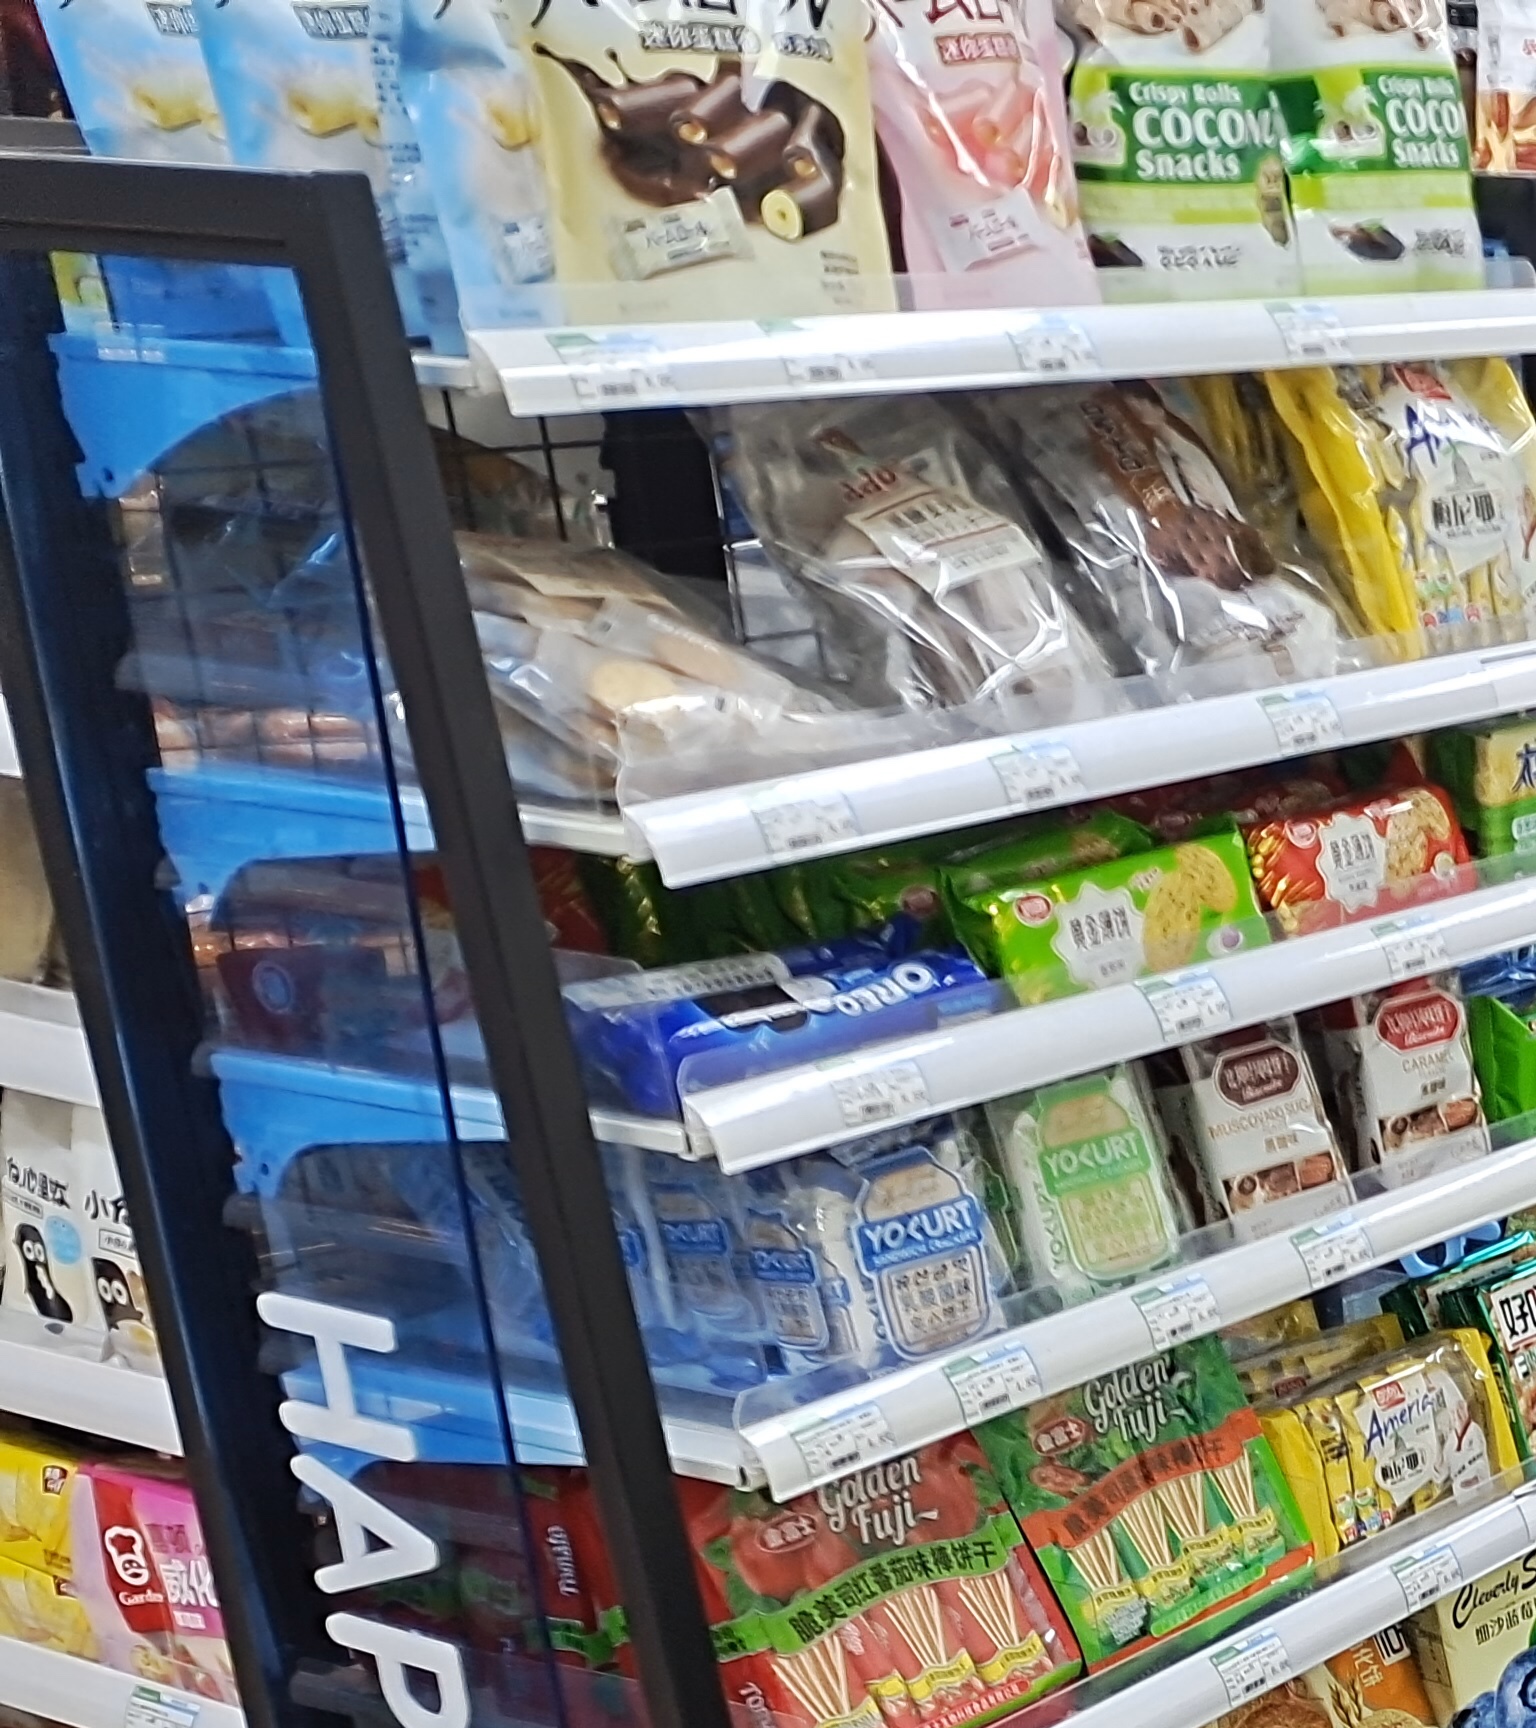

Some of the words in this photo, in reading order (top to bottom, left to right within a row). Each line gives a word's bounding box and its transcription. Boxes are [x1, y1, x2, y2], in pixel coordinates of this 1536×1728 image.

[1135, 149, 1241, 182] Snacks
[1391, 139, 1460, 169] Snacks
[864, 1200, 974, 1255] YOGURT
[1083, 1352, 1173, 1435] Golden
[1112, 1389, 1169, 1445] Fuji
[815, 1455, 924, 1535] Golden
[850, 1490, 920, 1548] Fuji
